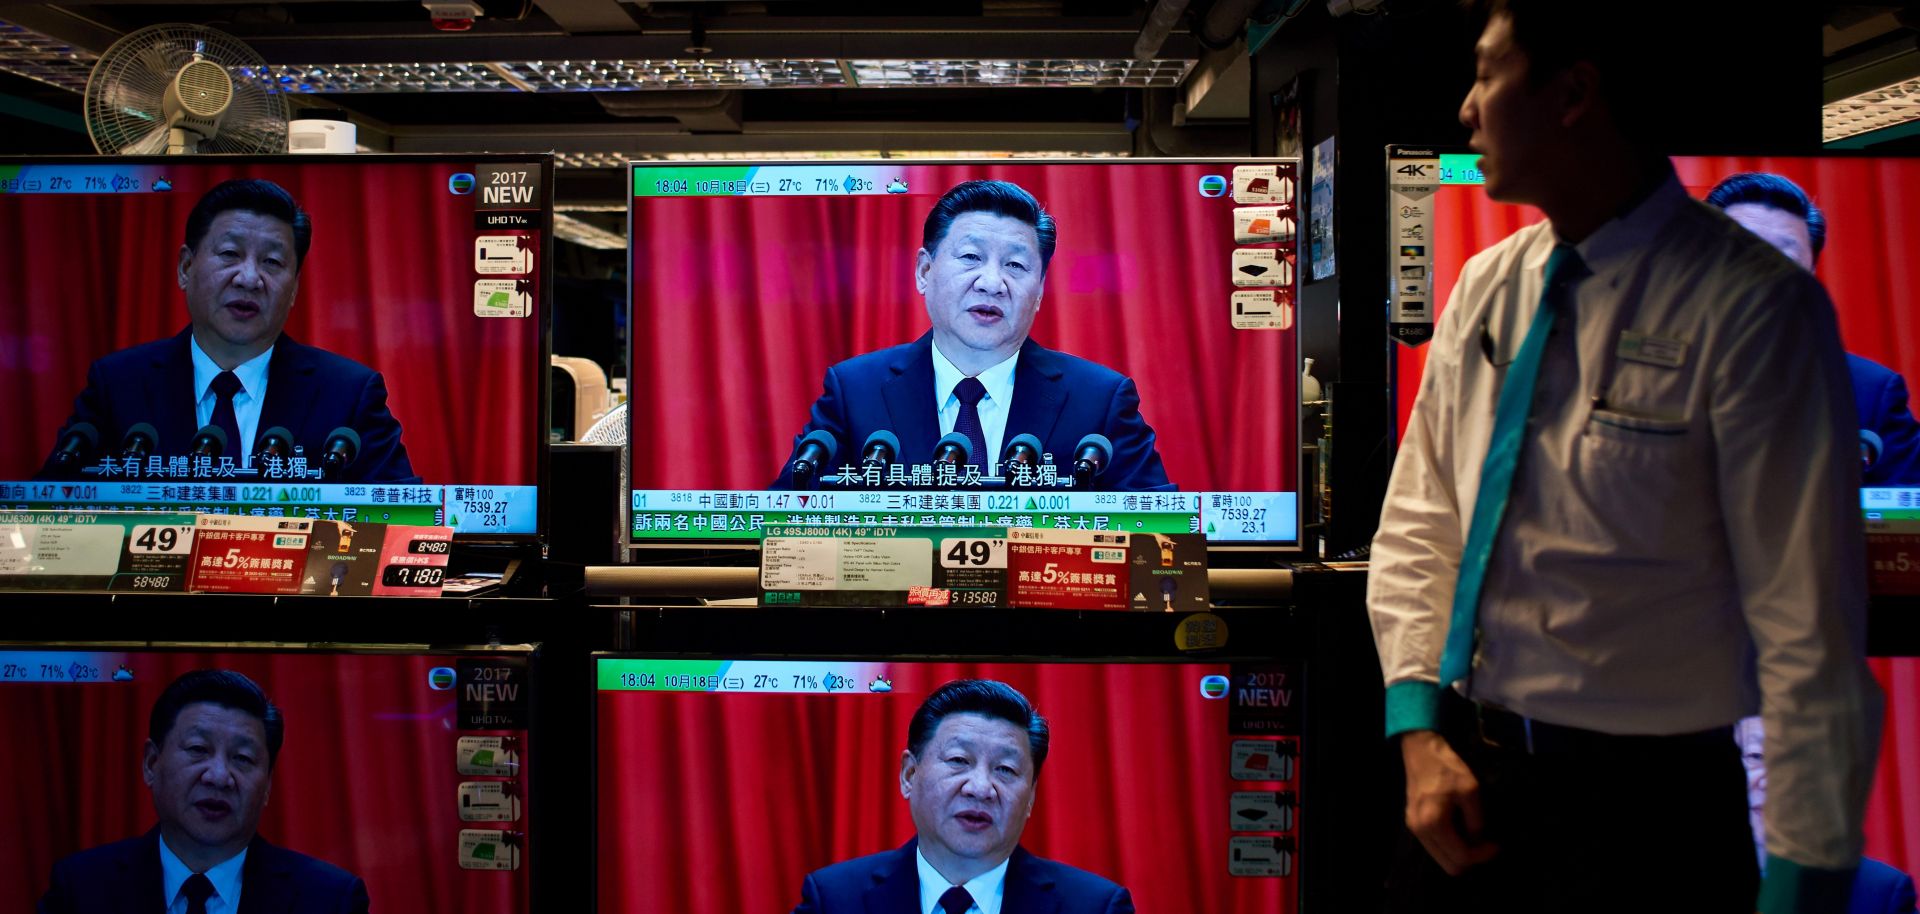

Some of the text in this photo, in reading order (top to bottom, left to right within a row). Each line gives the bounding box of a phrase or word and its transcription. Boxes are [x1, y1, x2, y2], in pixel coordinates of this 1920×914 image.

[1397, 165, 1426, 176] 4K
[85, 176, 107, 190] 71%
[492, 172, 527, 184] 2017
[655, 180, 688, 192] 18:04
[816, 179, 838, 192] 71%
[484, 186, 533, 204] NEW
[487, 216, 508, 225] UHD
[837, 463, 1073, 487] 未有具體提及「港獨」
[33, 486, 55, 499] 1.47
[74, 486, 97, 500] 0.01
[120, 486, 141, 495] 3822
[147, 486, 237, 501] 三和建築集團
[242, 487, 272, 501] 0.221
[291, 487, 321, 502] 0.001
[344, 487, 366, 496] 3823
[371, 487, 432, 504] 德普科技
[671, 493, 692, 502] 3818
[699, 493, 759, 509] 中國動向
[766, 494, 789, 508] 1.47
[811, 495, 834, 509] 0.01
[860, 494, 881, 503] 3822
[886, 494, 981, 511] 三和建築集團
[987, 495, 1019, 510] 0.221
[1039, 495, 1070, 510] 0.001
[1095, 495, 1117, 504] 3823
[1123, 495, 1185, 511] 德普科技
[1212, 494, 1252, 508] 富時100
[464, 501, 508, 513] 7539.27
[37, 515, 55, 525] (4K)
[75, 515, 97, 525] iDTV
[484, 514, 506, 526] 23.1
[1222, 508, 1267, 521] 7539.27
[767, 527, 781, 536] LG
[784, 527, 830, 537] 49SJ8000
[832, 527, 852, 538] (4K)
[874, 528, 897, 537] iDTV
[1242, 521, 1266, 534] 23.1
[133, 576, 170, 588] $8480
[41, 664, 64, 678] 71%
[473, 667, 511, 681] 2017
[620, 673, 655, 687] 18:04
[793, 675, 818, 689] 71%
[1247, 673, 1287, 688] 2017
[465, 683, 520, 703] NEW
[1239, 688, 1292, 708] NEW
